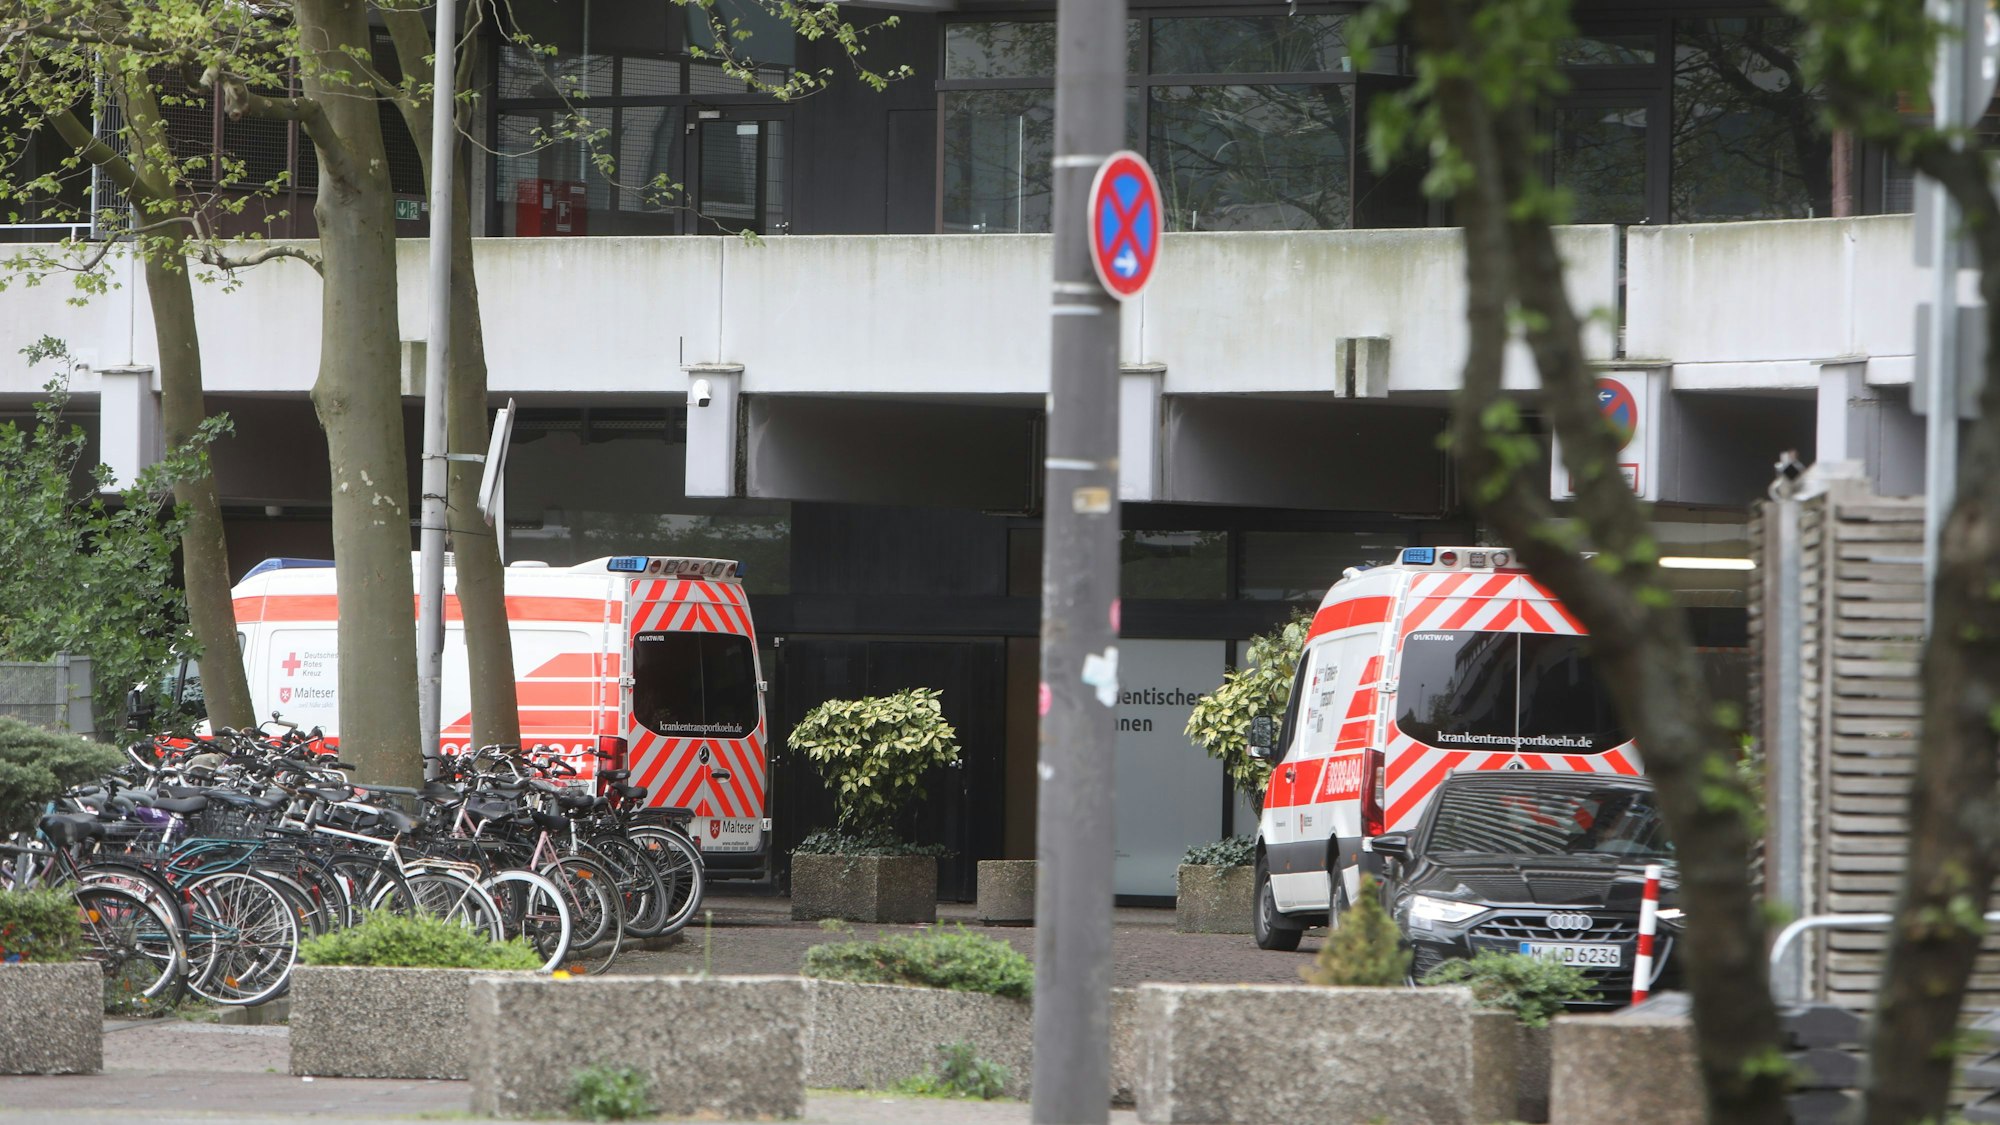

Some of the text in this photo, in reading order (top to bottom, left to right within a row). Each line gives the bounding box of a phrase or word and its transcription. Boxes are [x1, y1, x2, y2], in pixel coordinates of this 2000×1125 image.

[1413, 634, 1454, 642] 01/KTW/04
[304, 651, 339, 660] Deutsches
[303, 660, 322, 668] Rotes
[302, 669, 321, 677] Kreuz
[294, 687, 335, 699] Malteser
[1117, 687, 1205, 706] entisches
[659, 720, 743, 735] krankentransportkoeln.de
[1115, 717, 1152, 732] nen
[1437, 731, 1593, 749] krankentransportkoeln.de
[722, 820, 755, 834] Malteser
[1578, 948, 1619, 963] 6236
